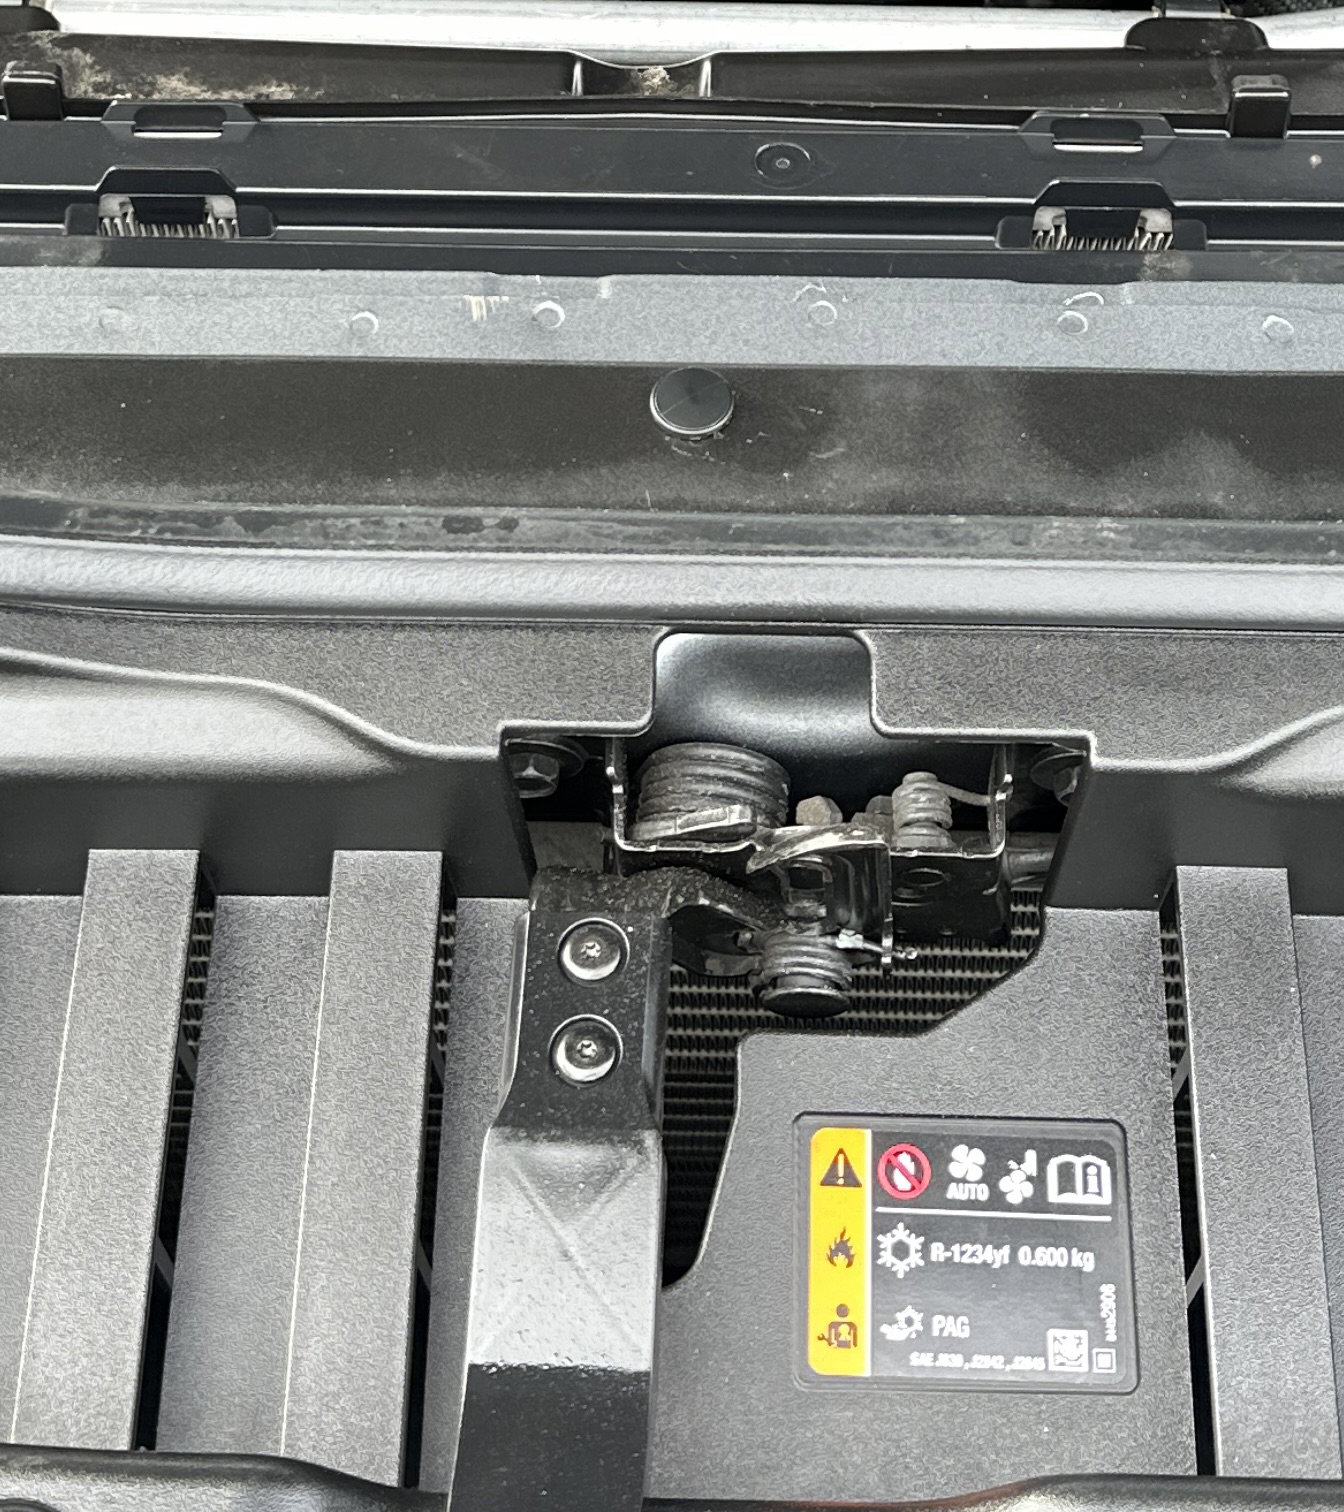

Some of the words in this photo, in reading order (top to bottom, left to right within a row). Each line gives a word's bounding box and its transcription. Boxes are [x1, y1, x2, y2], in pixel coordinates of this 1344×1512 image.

[947, 1183, 989, 1201] AUTO
[930, 1242, 1010, 1269] R-1234yf
[1018, 1246, 1068, 1267] 0.600
[1071, 1248, 1095, 1272] kg
[932, 1314, 970, 1339] PAG
